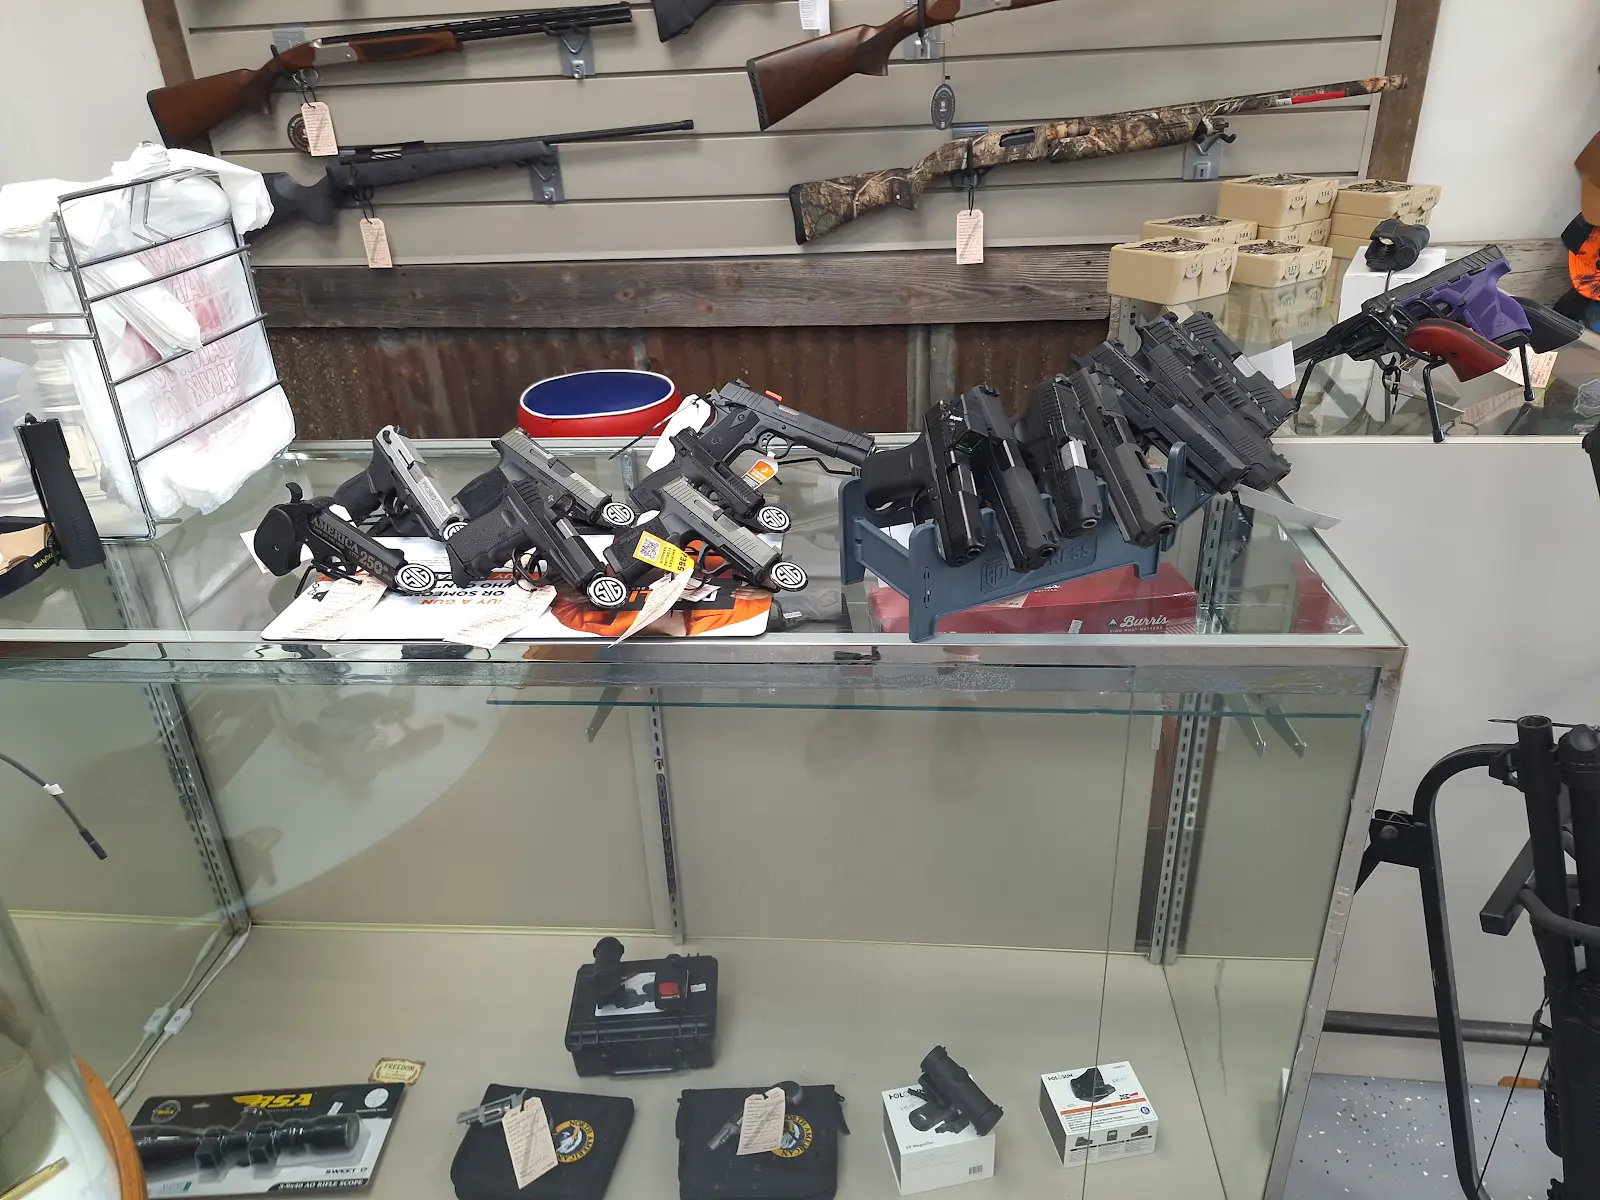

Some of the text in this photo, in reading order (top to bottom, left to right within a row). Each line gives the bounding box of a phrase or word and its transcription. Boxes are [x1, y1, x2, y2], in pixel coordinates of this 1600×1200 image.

[1294, 195, 1304, 203] 556
[310, 516, 360, 556] AMERICA
[1120, 615, 1170, 627] Burris
[384, 1062, 415, 1071] FREEDOM
